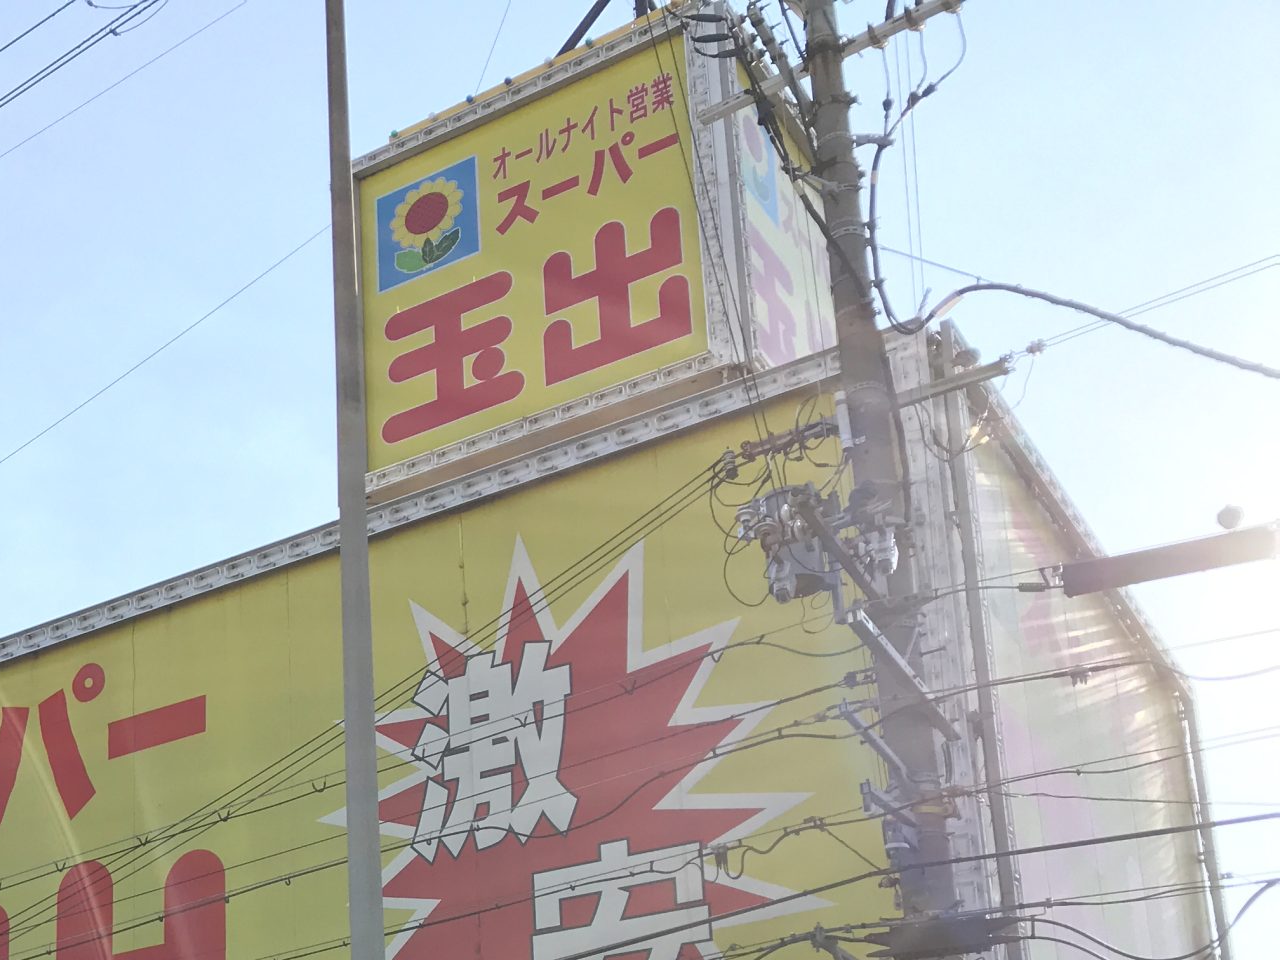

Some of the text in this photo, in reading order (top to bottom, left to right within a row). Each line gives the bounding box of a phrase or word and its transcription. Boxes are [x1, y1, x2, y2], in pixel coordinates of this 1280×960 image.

[492, 72, 675, 182] オールナイト営業
[495, 131, 680, 236] スーパー
[381, 206, 694, 445] 玉出
